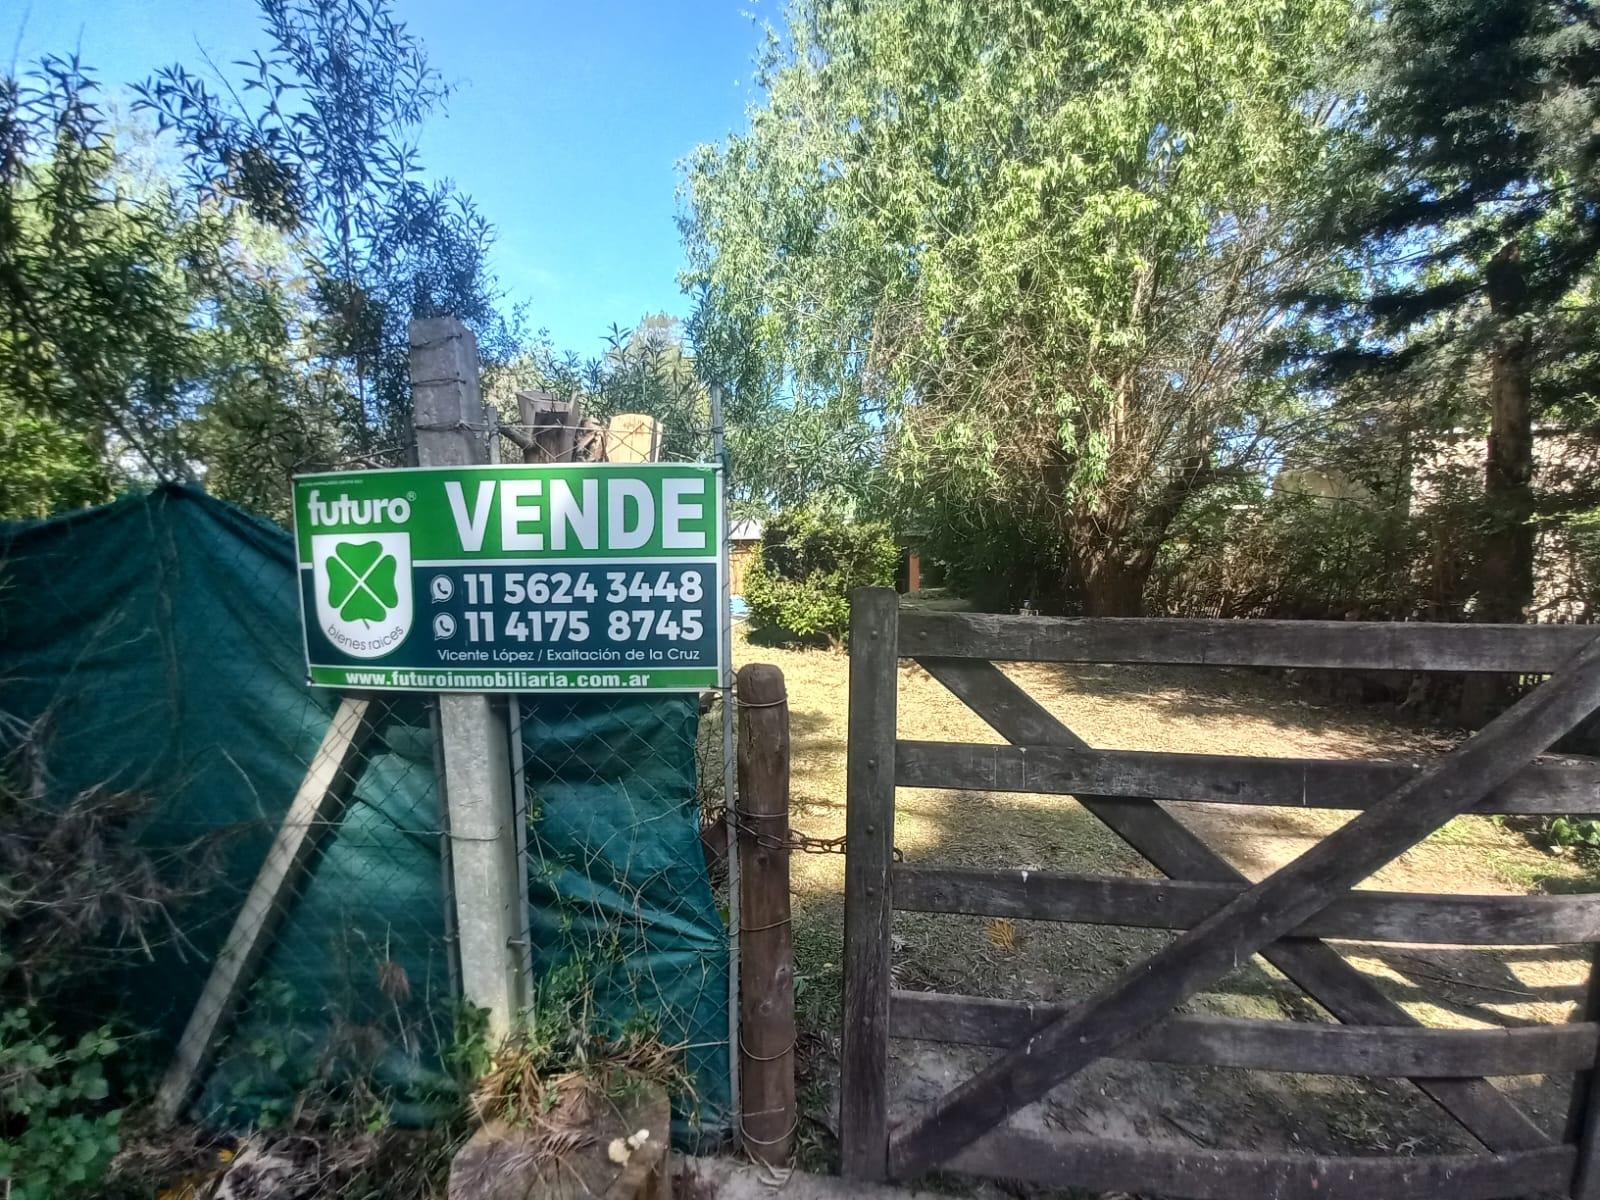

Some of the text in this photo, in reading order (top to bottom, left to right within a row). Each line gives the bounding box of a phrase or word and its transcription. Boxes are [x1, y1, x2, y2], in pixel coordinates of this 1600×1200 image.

[444, 478, 706, 552] VENDE
[463, 570, 704, 605] 11 5624 3448
[327, 623, 367, 651] bienes
[464, 609, 704, 642] 11 4175 8745
[437, 648, 490, 661] Vicente
[493, 647, 535, 663] López
[547, 647, 621, 661] Exaltación
[625, 648, 646, 661] de
[649, 648, 664, 661] la
[667, 647, 701, 661] Cruz
[345, 671, 651, 688] www.futuroinmobiliaria.com.ar
